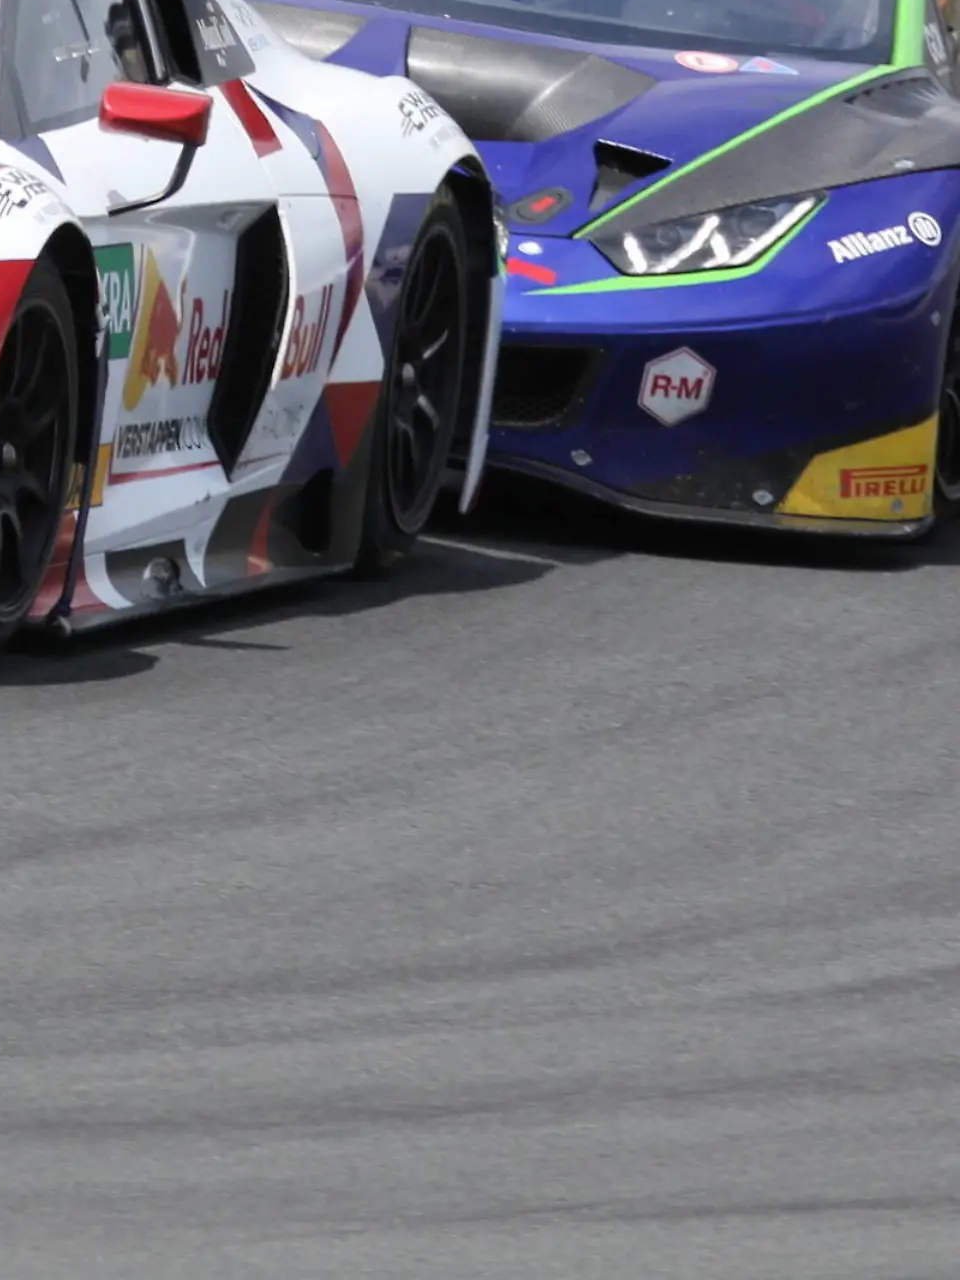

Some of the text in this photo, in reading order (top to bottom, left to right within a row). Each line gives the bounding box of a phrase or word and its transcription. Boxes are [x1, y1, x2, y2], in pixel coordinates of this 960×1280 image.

[827, 223, 913, 263] Allianz
[183, 284, 333, 386] Red Bull
[649, 374, 704, 402] R-M
[840, 463, 928, 500] PIRELLI
